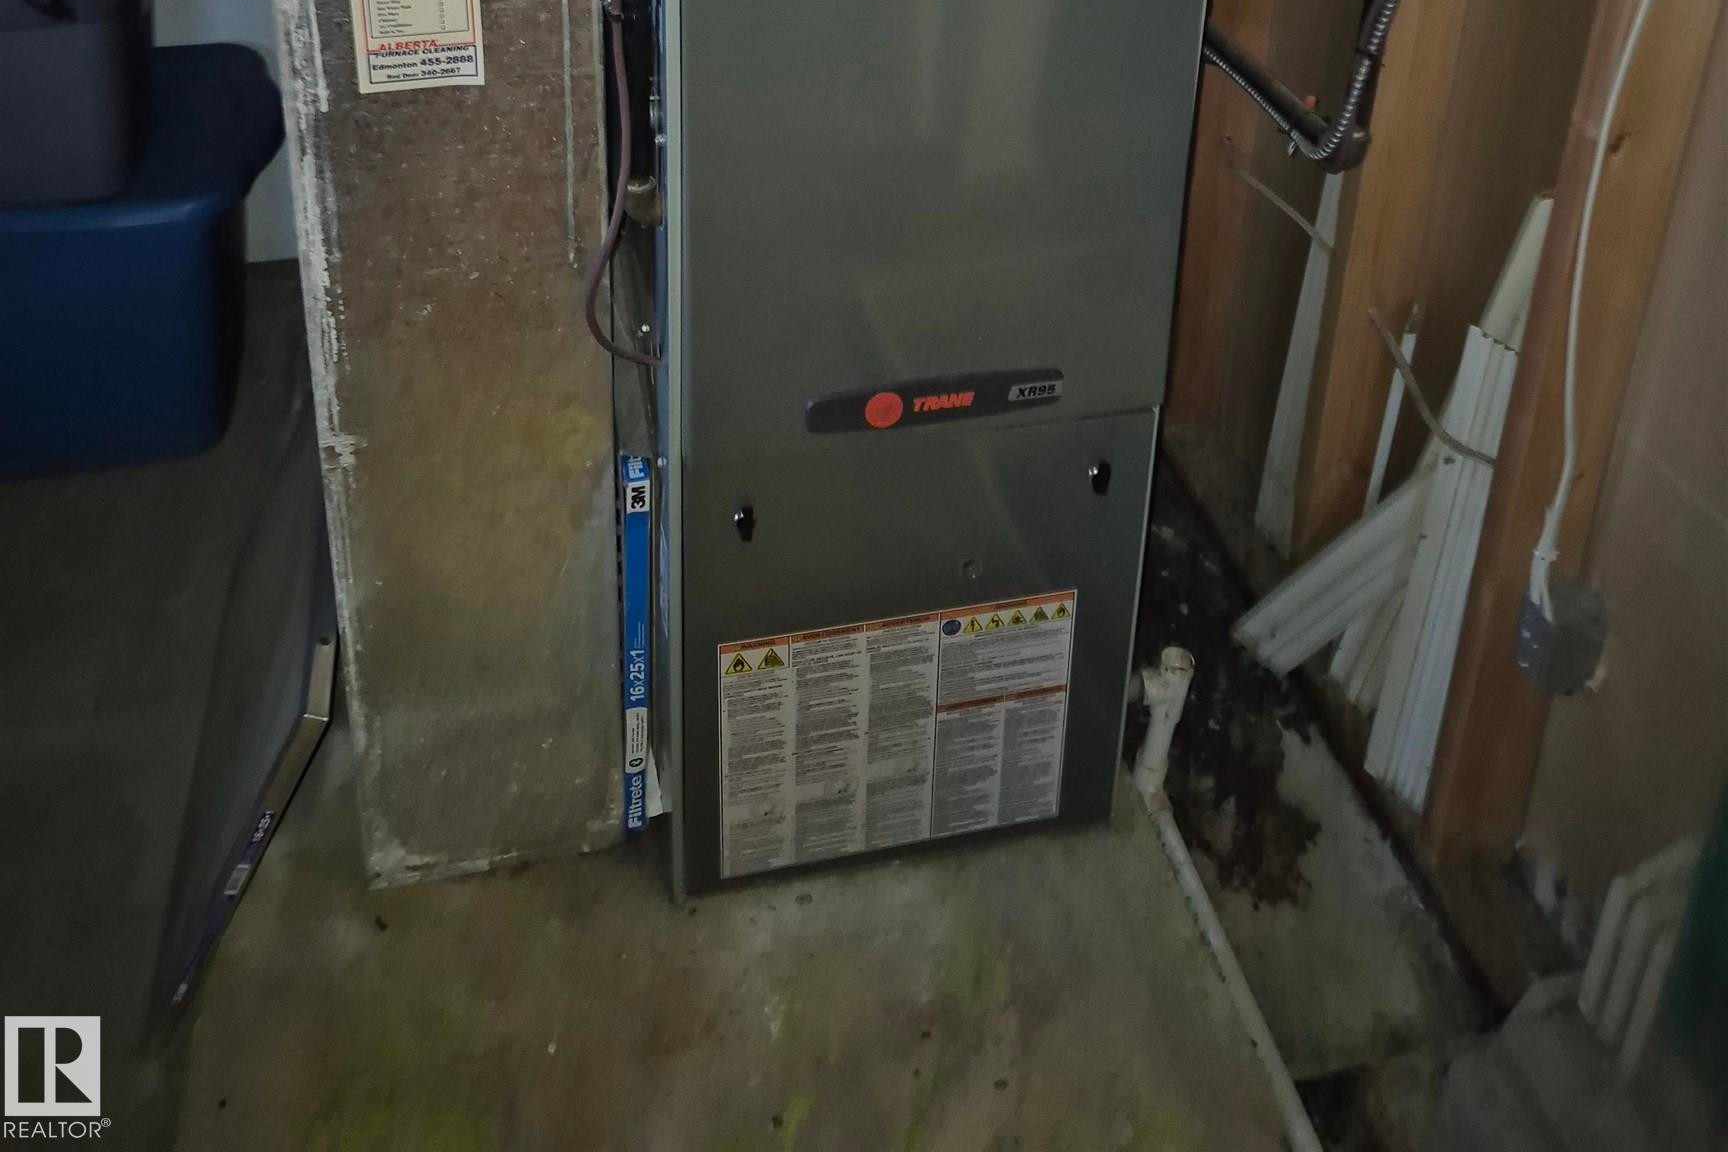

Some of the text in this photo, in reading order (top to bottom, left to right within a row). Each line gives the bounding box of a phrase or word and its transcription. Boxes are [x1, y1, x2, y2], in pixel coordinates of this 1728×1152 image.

[376, 45, 470, 58] FURNACE CLEANING
[379, 39, 438, 52] ALBERTA
[372, 55, 474, 71] Edmonton 455-2888
[1016, 384, 1057, 399] XR95
[913, 391, 976, 413] TRANE
[630, 485, 647, 511] 3M
[629, 649, 646, 702] 16x25x1
[627, 775, 645, 829] Filtrete
